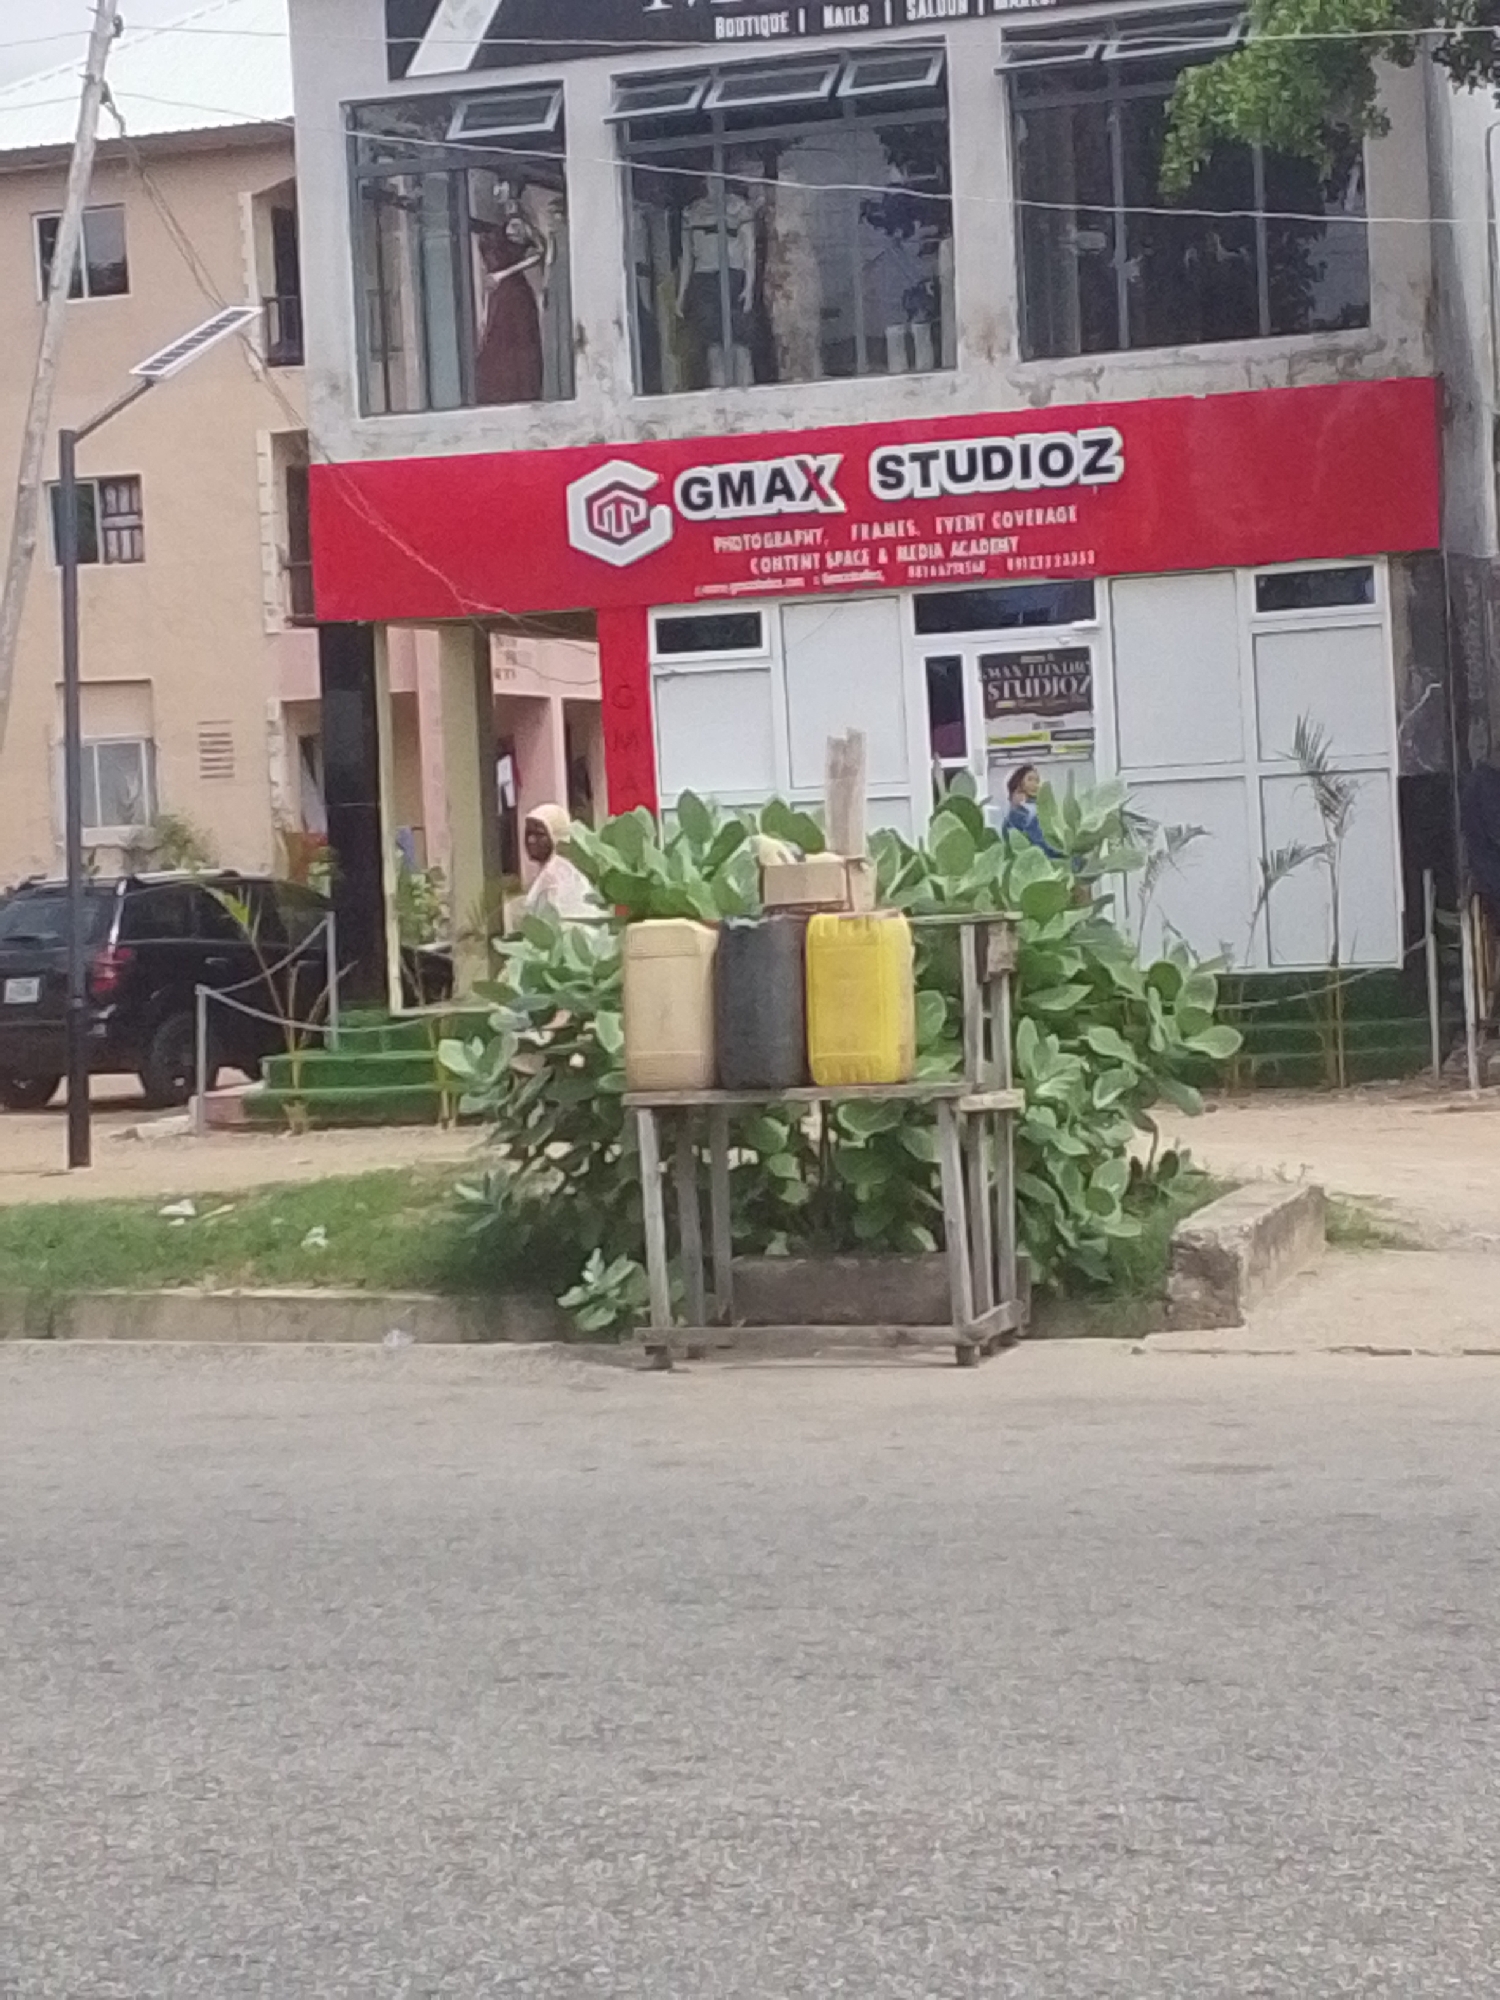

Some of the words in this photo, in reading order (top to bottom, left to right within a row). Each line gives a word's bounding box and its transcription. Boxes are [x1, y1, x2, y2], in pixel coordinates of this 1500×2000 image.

[715, 11, 790, 39] BOUTIQUE
[824, 4, 869, 29] NAILS
[676, 454, 845, 520] GMAX
[871, 429, 1123, 499] STUDIOZ
[935, 513, 985, 535] EVENT
[992, 505, 1078, 529] COVERAGE
[750, 552, 820, 574] CONTENT
[825, 547, 869, 569] SPACE
[896, 542, 944, 561] MEDIA
[950, 536, 1019, 557] ACADEMY
